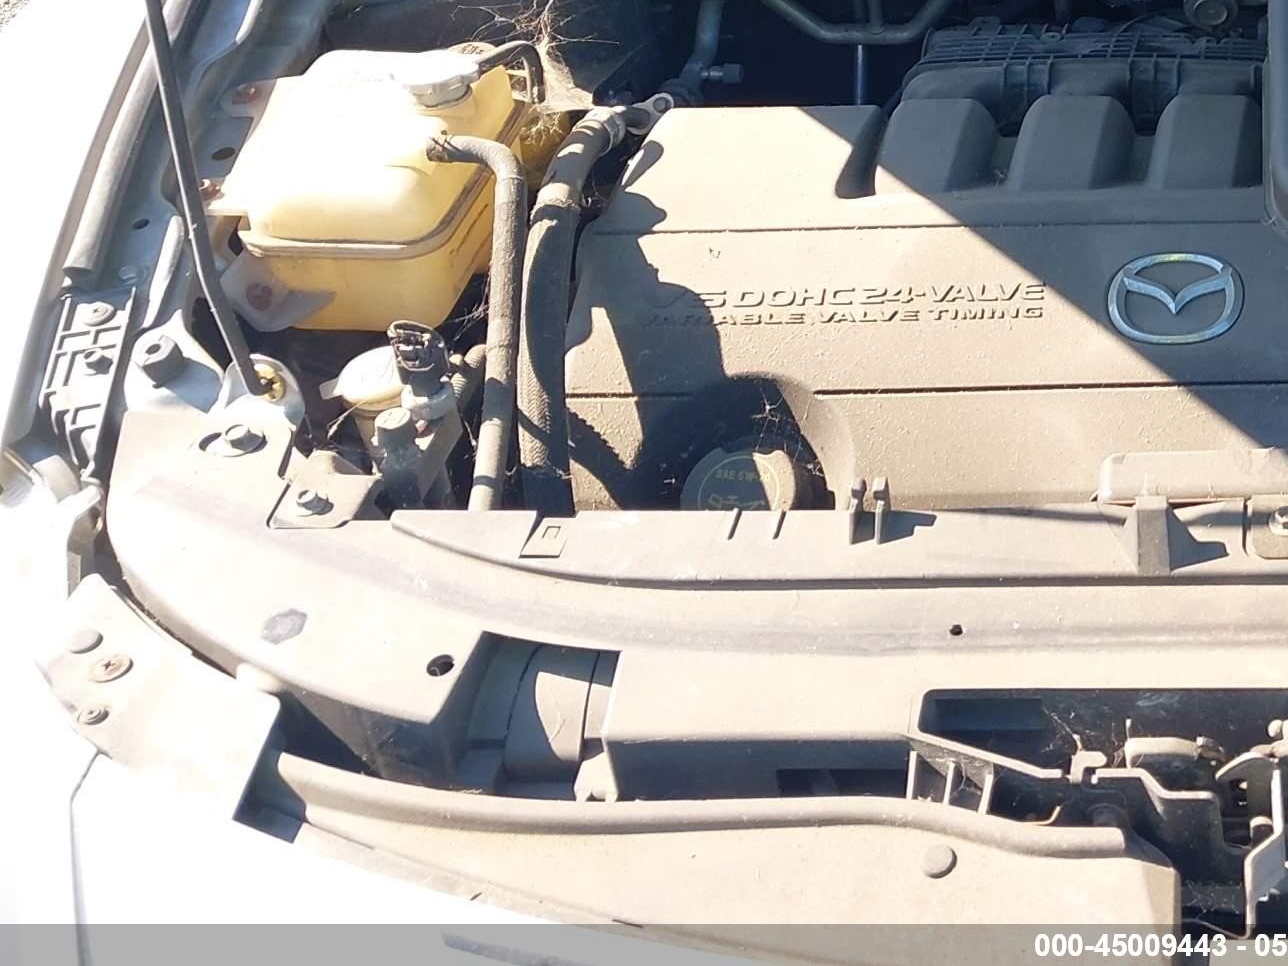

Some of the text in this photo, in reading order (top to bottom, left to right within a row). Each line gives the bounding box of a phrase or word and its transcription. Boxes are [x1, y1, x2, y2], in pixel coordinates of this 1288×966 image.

[733, 287, 856, 308] DOHC
[859, 283, 1047, 306] 24-VALVE
[642, 306, 1045, 327] VARIABLE VALVE TIMING
